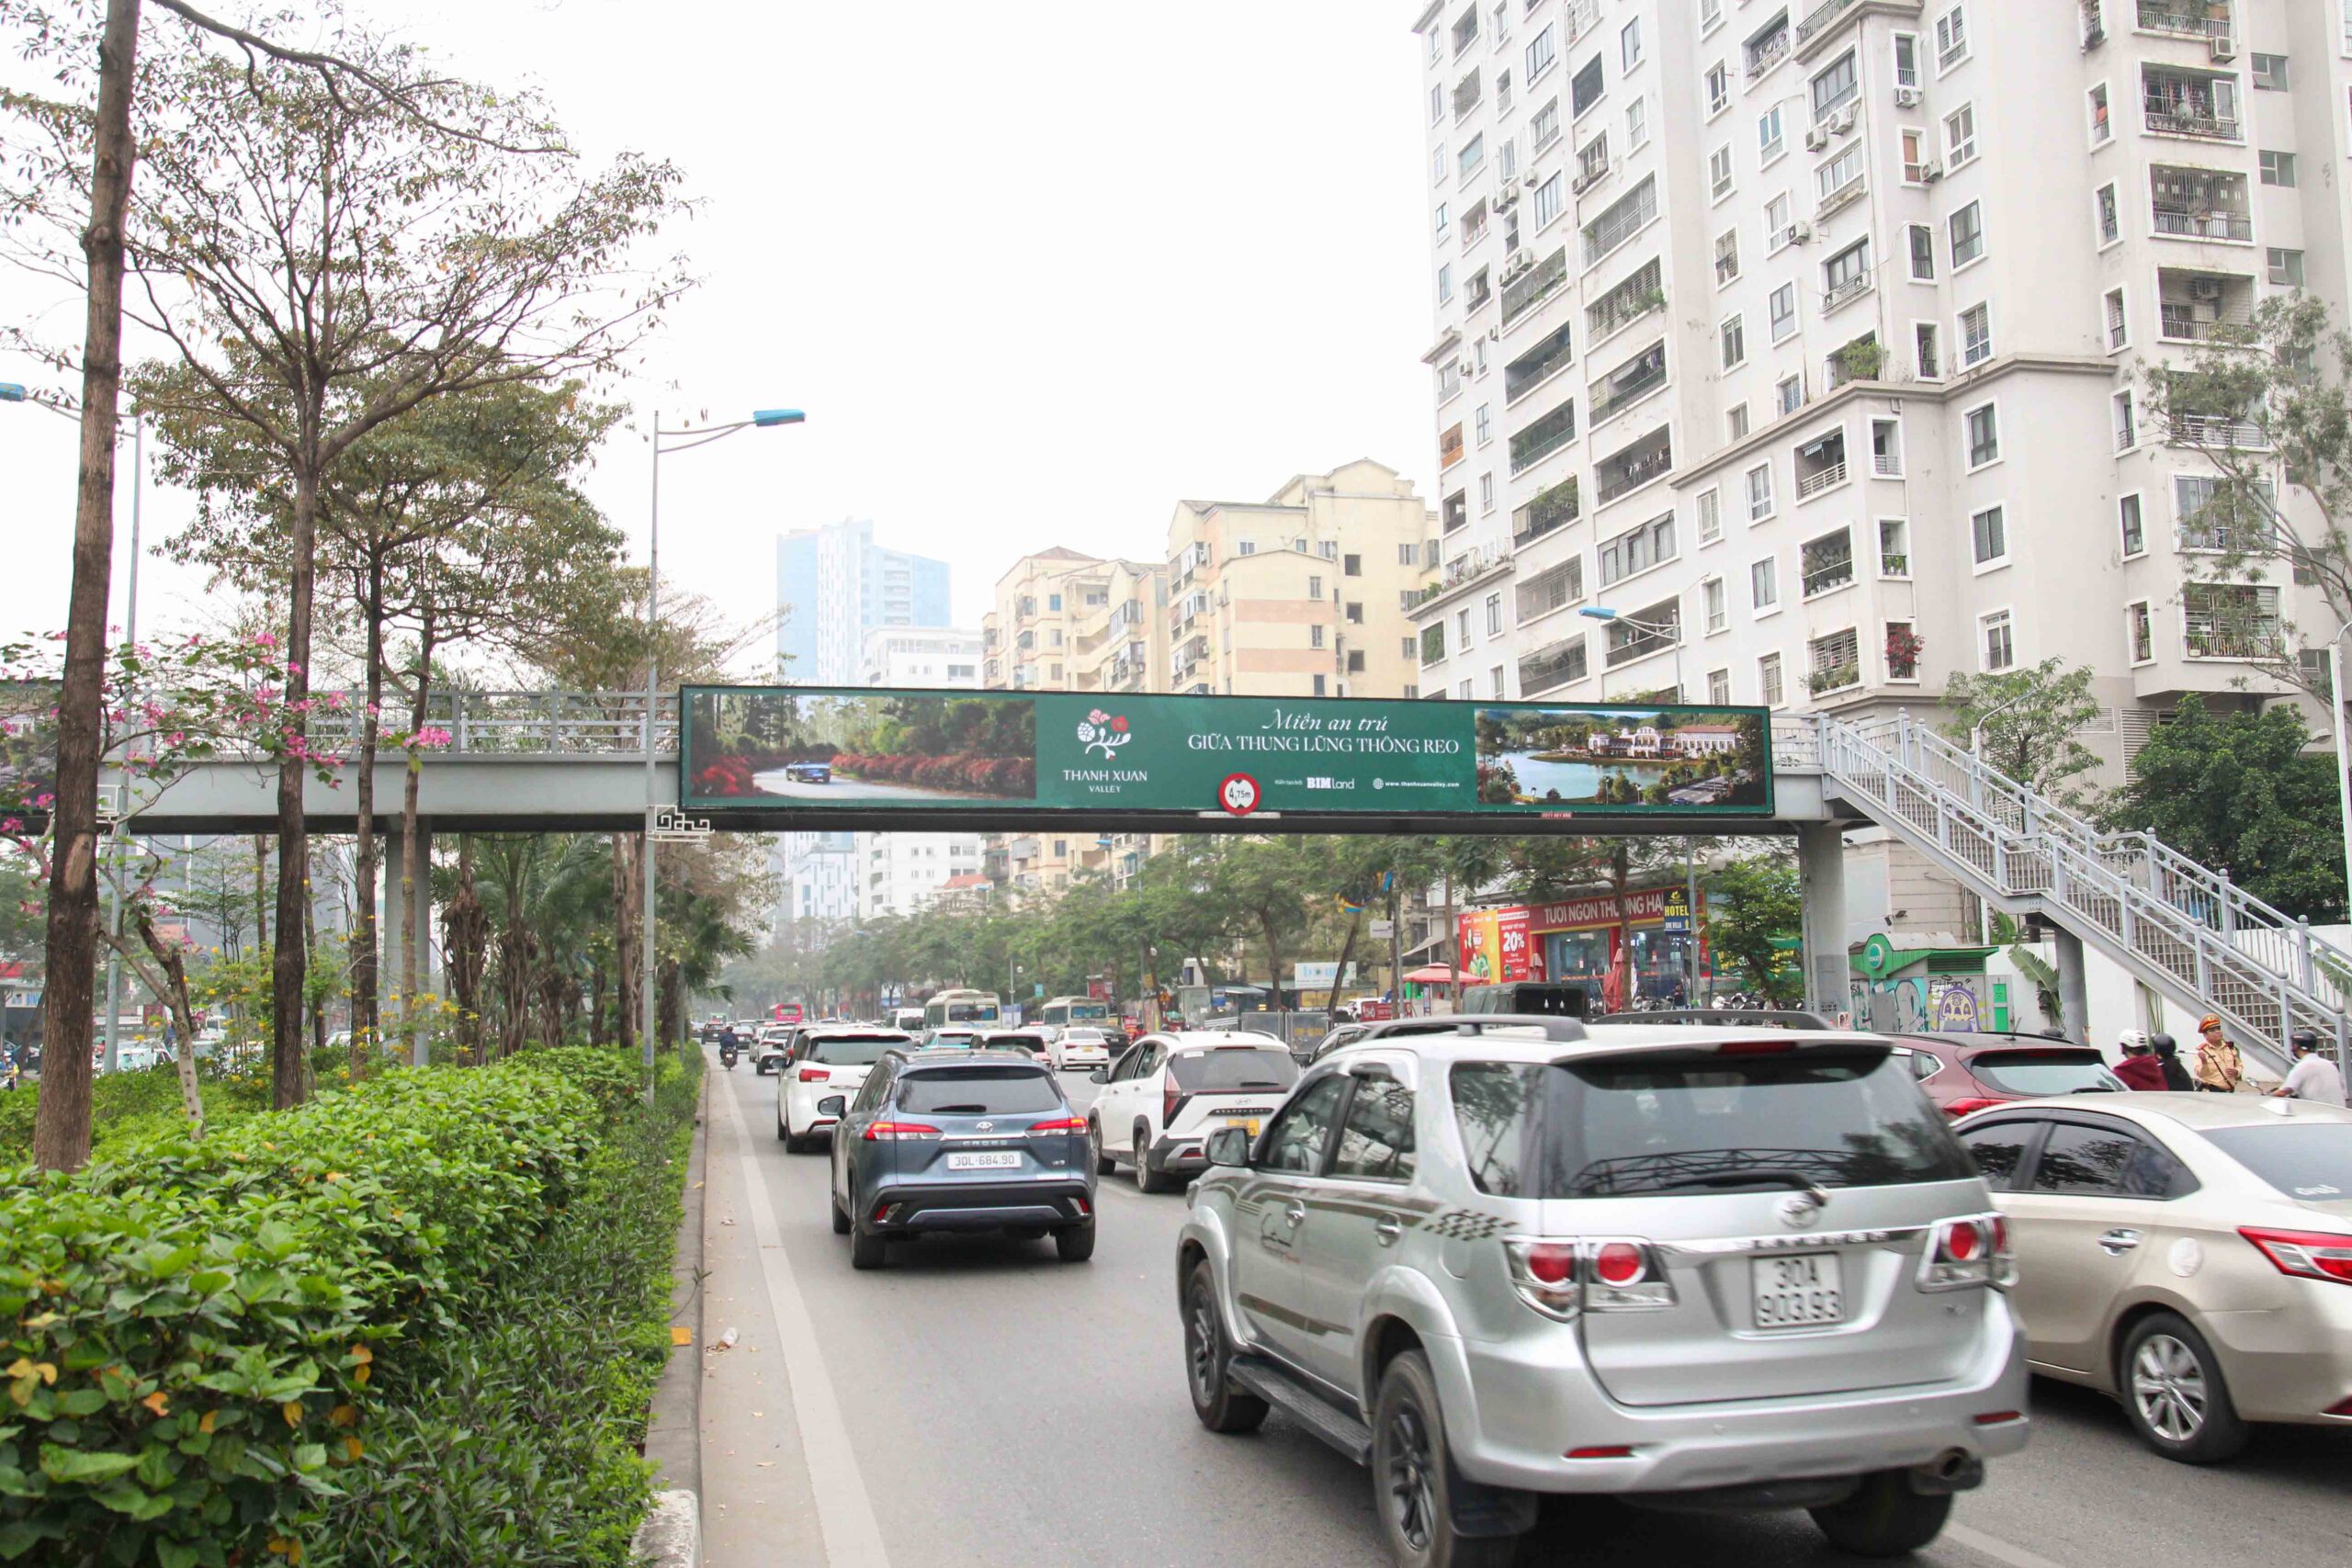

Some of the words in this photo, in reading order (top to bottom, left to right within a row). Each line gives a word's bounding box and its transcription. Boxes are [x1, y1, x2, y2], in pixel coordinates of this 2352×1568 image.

[1261, 708, 1321, 730] Miền
[1328, 718, 1351, 730] an
[1358, 716, 1388, 731] trú
[1187, 733, 1233, 750] GIỮA
[1236, 735, 1300, 751] THUNG
[1304, 735, 1352, 752] LŨNG
[1356, 736, 1419, 753] THÔNG
[1423, 739, 1460, 754] REO
[1063, 770, 1109, 782] THANH
[1112, 770, 1148, 782] XUAN
[1664, 905, 1690, 917] HOTEL
[1502, 931, 1525, 953] 20%
